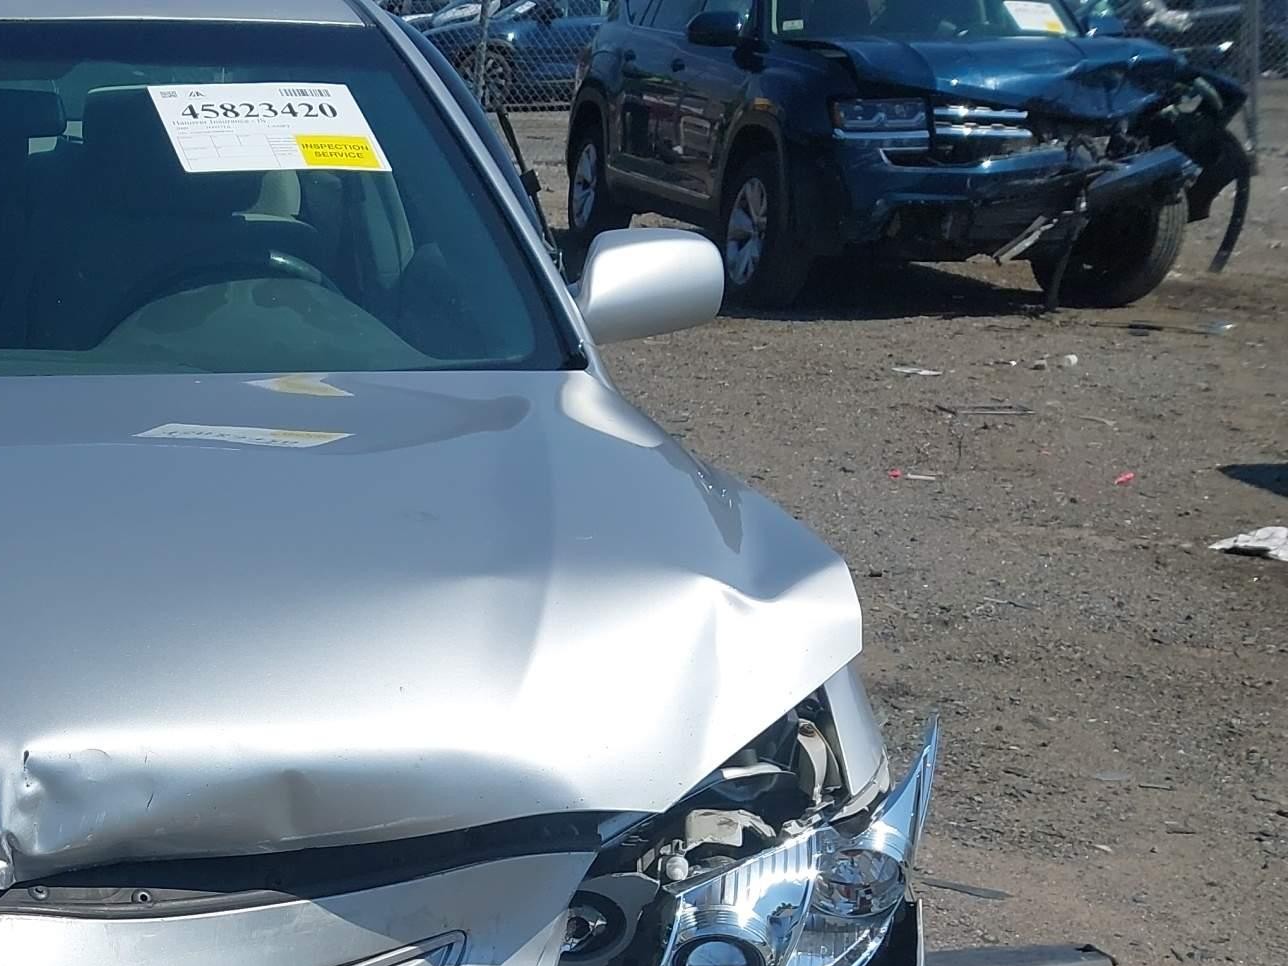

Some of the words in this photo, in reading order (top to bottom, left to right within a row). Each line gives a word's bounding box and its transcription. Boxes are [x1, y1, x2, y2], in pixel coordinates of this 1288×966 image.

[181, 102, 338, 119] 45823420
[301, 143, 369, 151] INSPECTION
[314, 151, 365, 159] SERVICE
